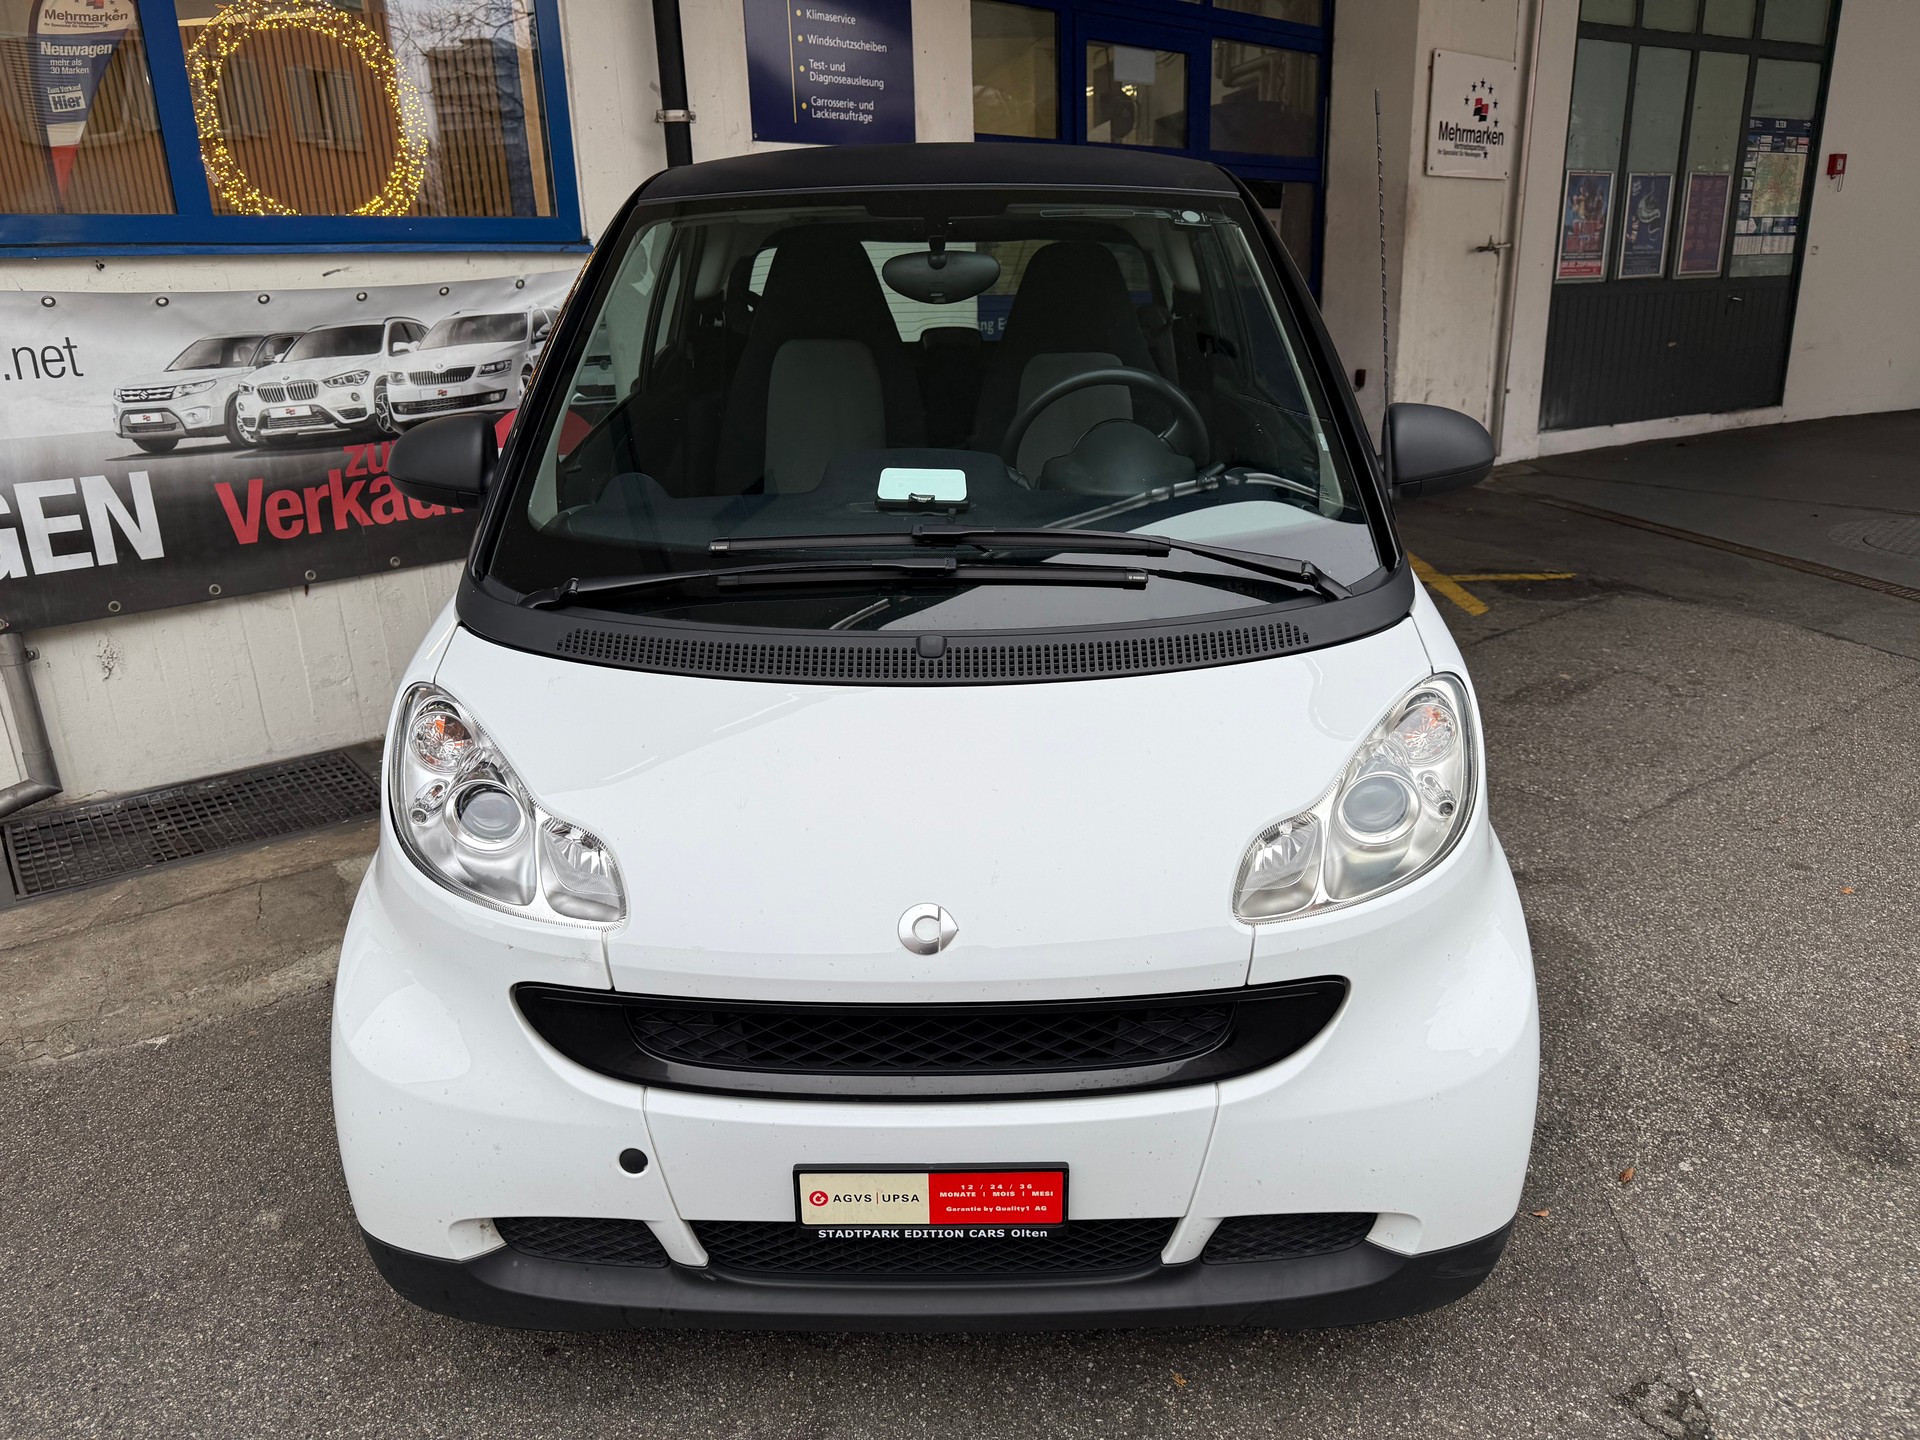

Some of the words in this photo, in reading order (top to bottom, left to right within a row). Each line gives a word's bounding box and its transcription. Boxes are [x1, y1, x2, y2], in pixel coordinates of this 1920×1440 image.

[44, 9, 128, 22] Mehrmarken
[806, 9, 856, 25] Klimaservice
[41, 41, 112, 57] Neuwagen
[807, 34, 887, 53] Windschutzscheiben
[71, 58, 82, 66] als
[809, 59, 828, 70] Test-
[830, 62, 846, 72] und
[61, 66, 89, 74] Marken
[810, 71, 885, 90] Diagnoseauslesung
[51, 95, 82, 110] Hier
[811, 96, 857, 110] Carrosserie-
[859, 101, 874, 110] und
[812, 108, 873, 124] Lackieraufträge
[1438, 120, 1504, 146] Mehrmarken
[343, 440, 398, 477] zu
[214, 468, 464, 545] Verka
[833, 1194, 872, 1203] AGVS
[882, 1194, 920, 1203] UPSA
[995, 1205, 1030, 1213] Quality1
[818, 1229, 900, 1239] STADTPARK
[904, 1229, 964, 1239] EDITION
[968, 1229, 1006, 1239] CARS
[1010, 1229, 1048, 1238] Olten
